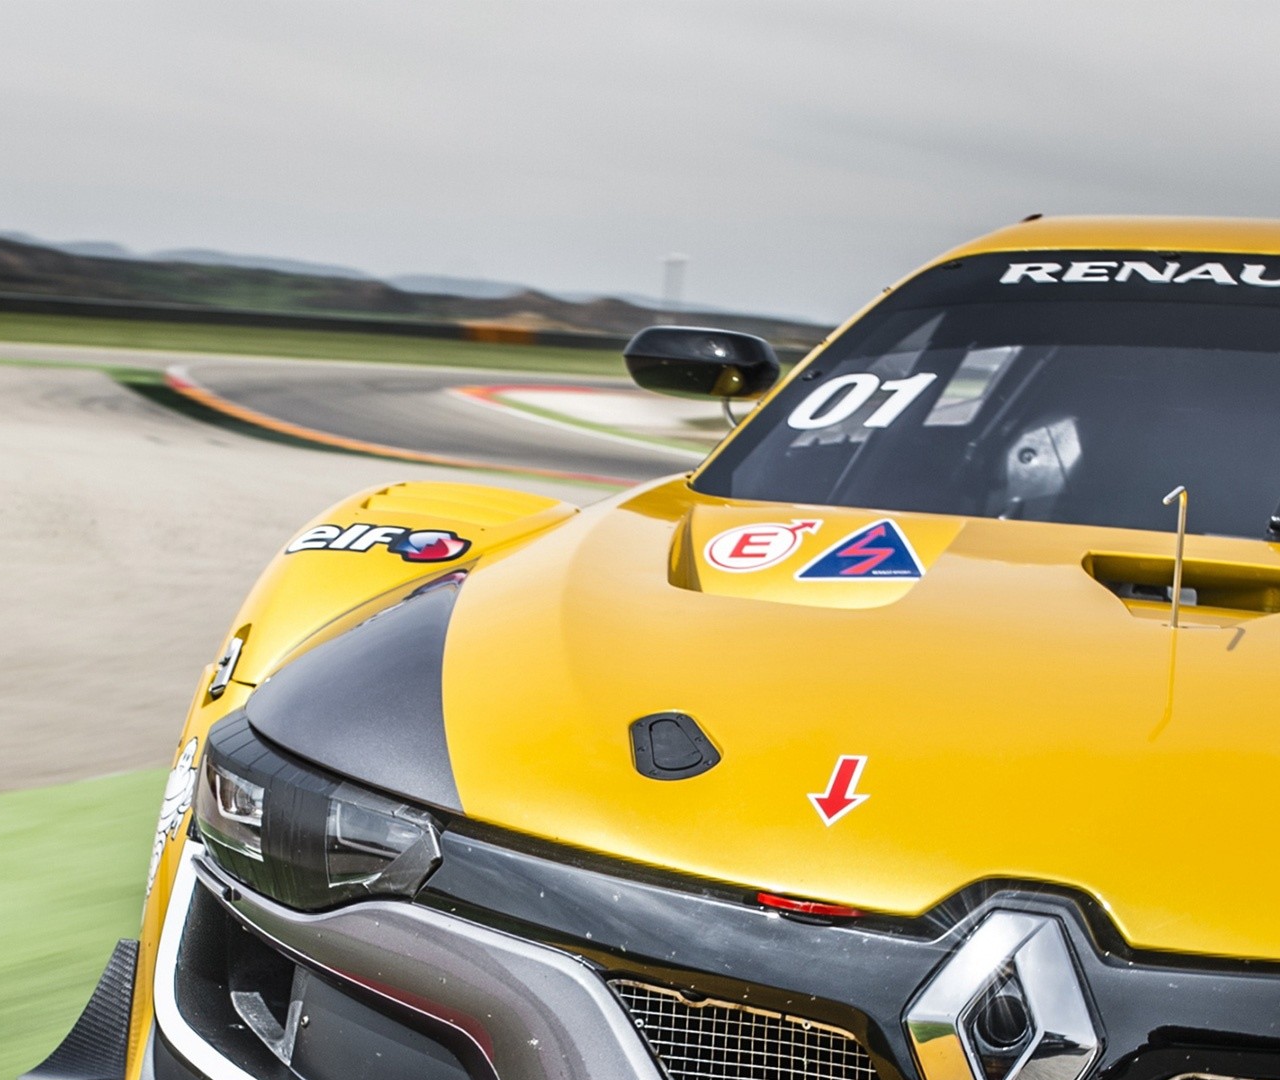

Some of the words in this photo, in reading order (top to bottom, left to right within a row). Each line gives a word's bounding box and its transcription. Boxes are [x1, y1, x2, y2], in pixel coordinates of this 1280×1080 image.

[786, 373, 938, 430] 01
[286, 523, 405, 554] elf
[729, 531, 778, 559] E
